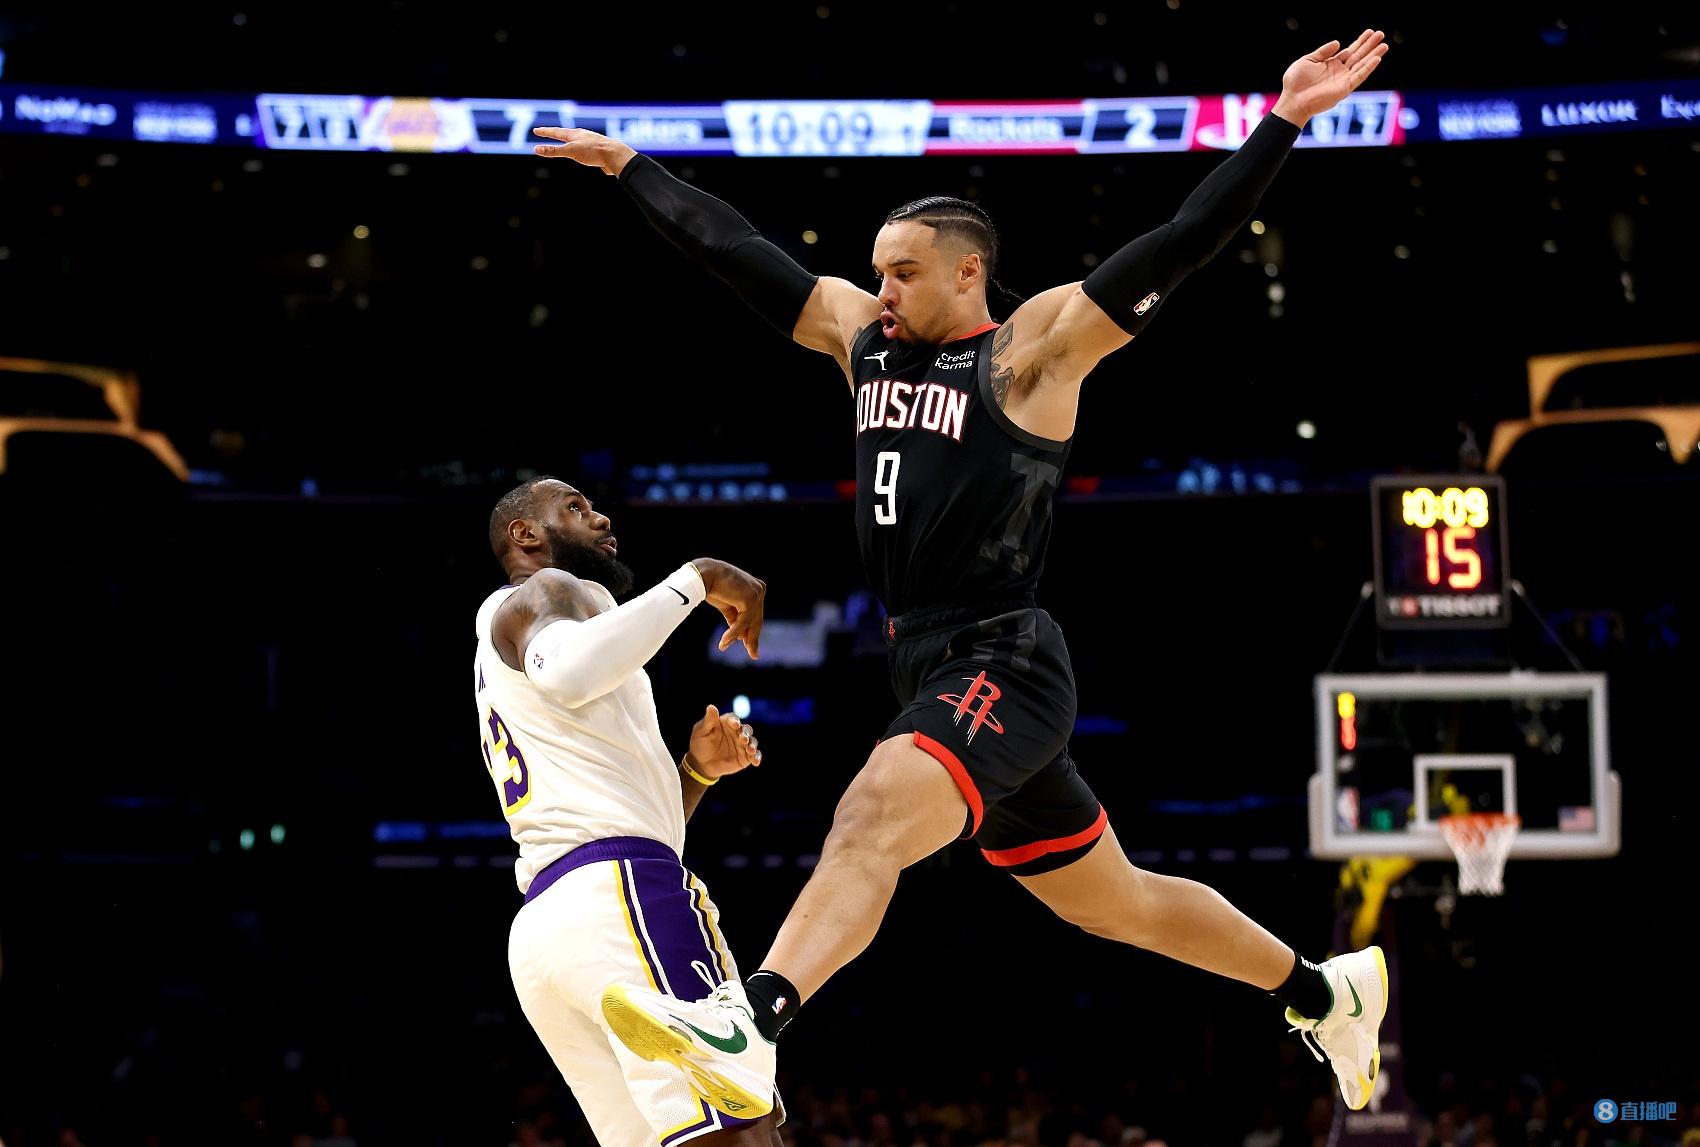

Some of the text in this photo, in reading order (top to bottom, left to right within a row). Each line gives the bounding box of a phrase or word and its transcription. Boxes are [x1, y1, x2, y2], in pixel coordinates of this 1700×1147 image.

[503, 104, 537, 149] 7
[750, 110, 873, 148] 10:09
[1124, 104, 1157, 148] 2
[1541, 101, 1638, 126] LUXOR
[857, 379, 969, 444] OUSTON
[874, 451, 901, 525] 9
[1402, 487, 1489, 528] 10:09
[1425, 525, 1482, 590] 15
[483, 705, 532, 814] 3
